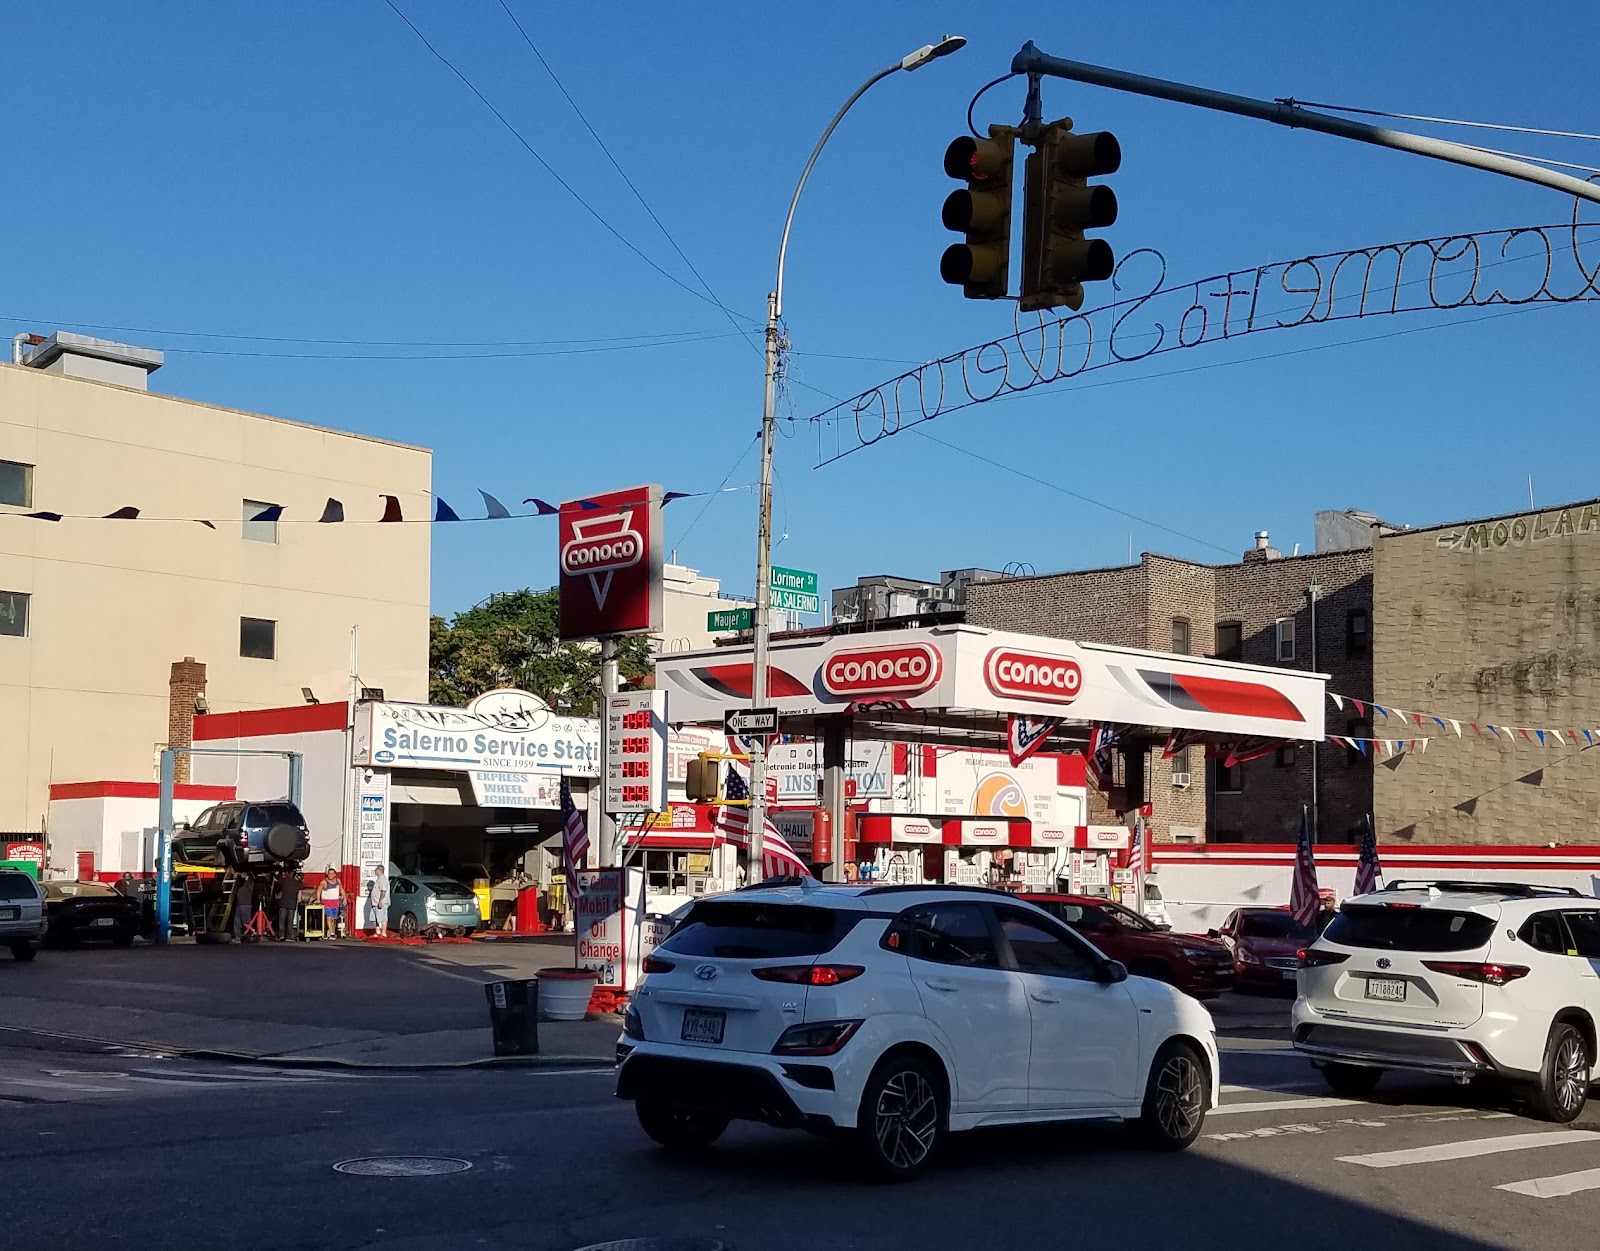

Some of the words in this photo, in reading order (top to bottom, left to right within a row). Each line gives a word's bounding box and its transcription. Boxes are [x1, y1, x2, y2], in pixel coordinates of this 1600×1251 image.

[1461, 505, 1600, 551] MOOLAH
[772, 569, 804, 589] Lorimer
[770, 590, 782, 607] VIA
[783, 592, 818, 612] SALERNO
[714, 613, 740, 630] Maujer
[640, 701, 650, 709] Full
[732, 716, 748, 727] ONE
[755, 715, 771, 727] WAY
[383, 727, 468, 754] Salerno
[473, 733, 549, 758] Service
[553, 740, 598, 761] Stati
[483, 758, 511, 768] SINCE
[514, 759, 534, 769] 1959
[578, 764, 600, 773] 718-3
[764, 761, 796, 771] lectronic
[476, 772, 529, 783] EXPRESS
[483, 783, 524, 794] WHEEL
[846, 784, 852, 793] 1
[579, 895, 609, 914] Mobil
[591, 920, 607, 938] Oil
[647, 924, 664, 935] FULL
[643, 935, 663, 945] SERV
[579, 940, 620, 963] Change
